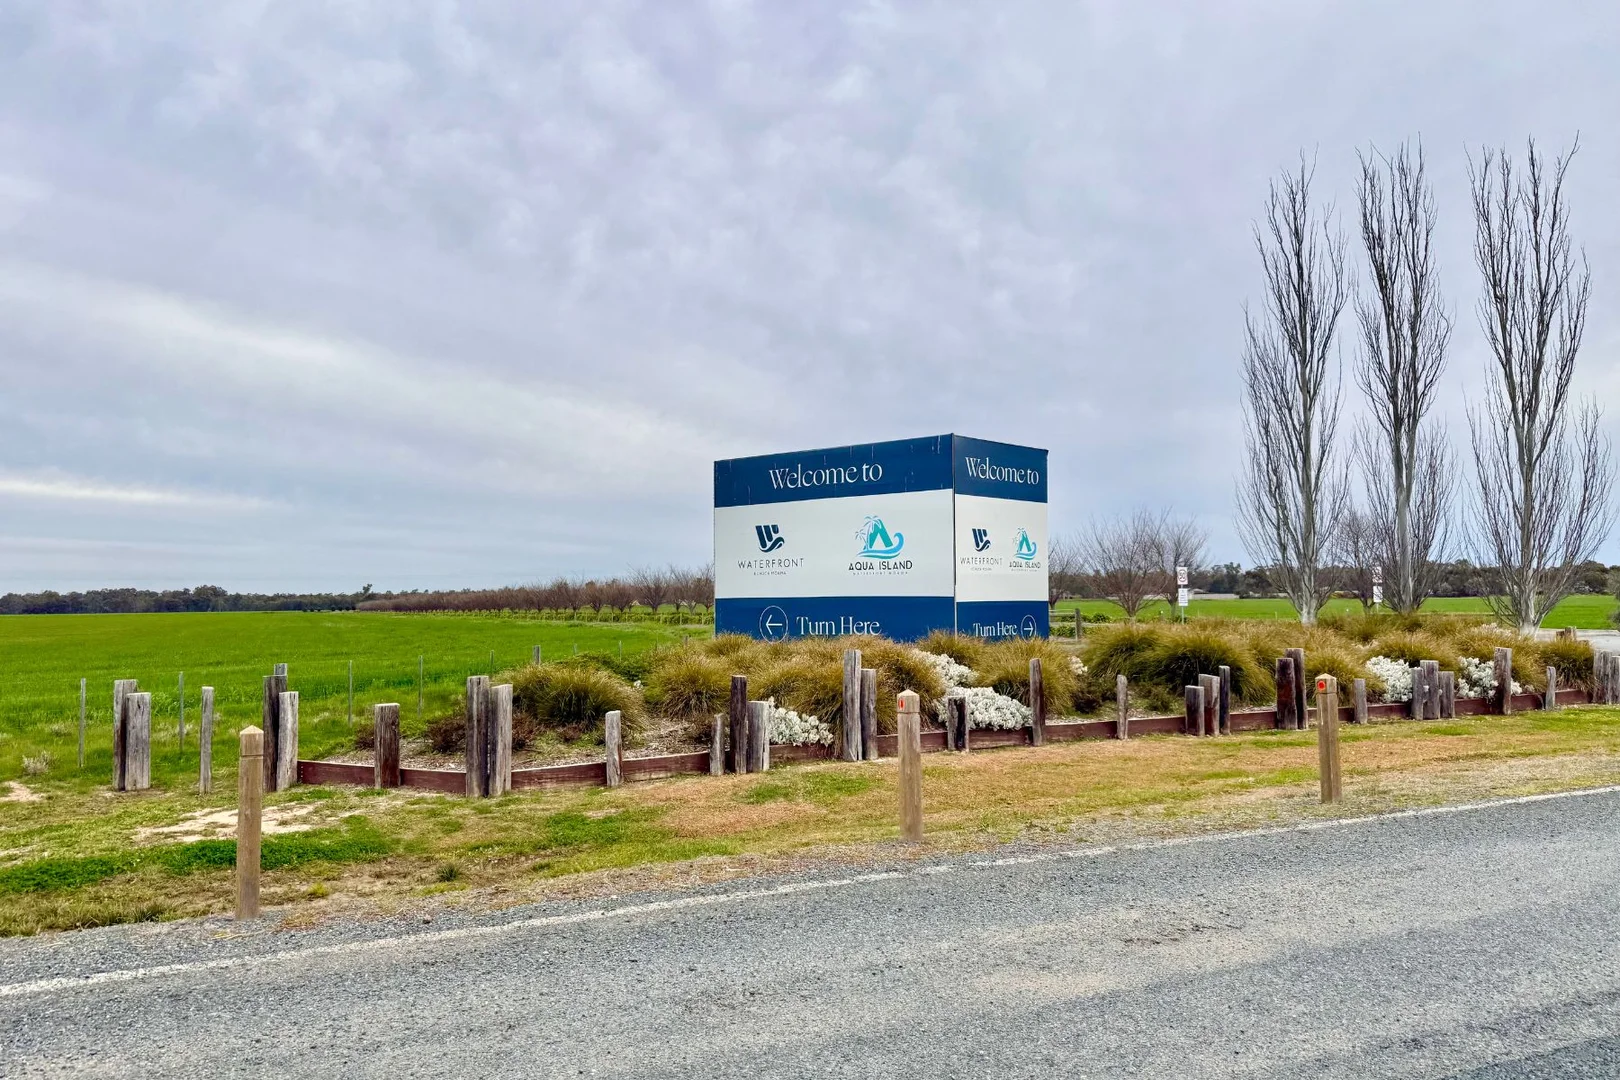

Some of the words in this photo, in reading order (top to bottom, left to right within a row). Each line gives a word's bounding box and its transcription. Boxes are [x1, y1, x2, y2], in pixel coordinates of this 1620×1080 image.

[769, 464, 859, 489] Welcome
[862, 463, 883, 482] to
[965, 456, 1025, 482] Welcome
[1027, 468, 1040, 485] to
[737, 558, 804, 569] WATERFRONT
[848, 561, 875, 571] AQUA
[879, 560, 913, 571] ISLAND
[960, 557, 1003, 566] WATERFRONT
[796, 616, 836, 637] Turn
[840, 616, 882, 636] Here
[973, 622, 996, 637] Turn
[996, 621, 1018, 636] Here
